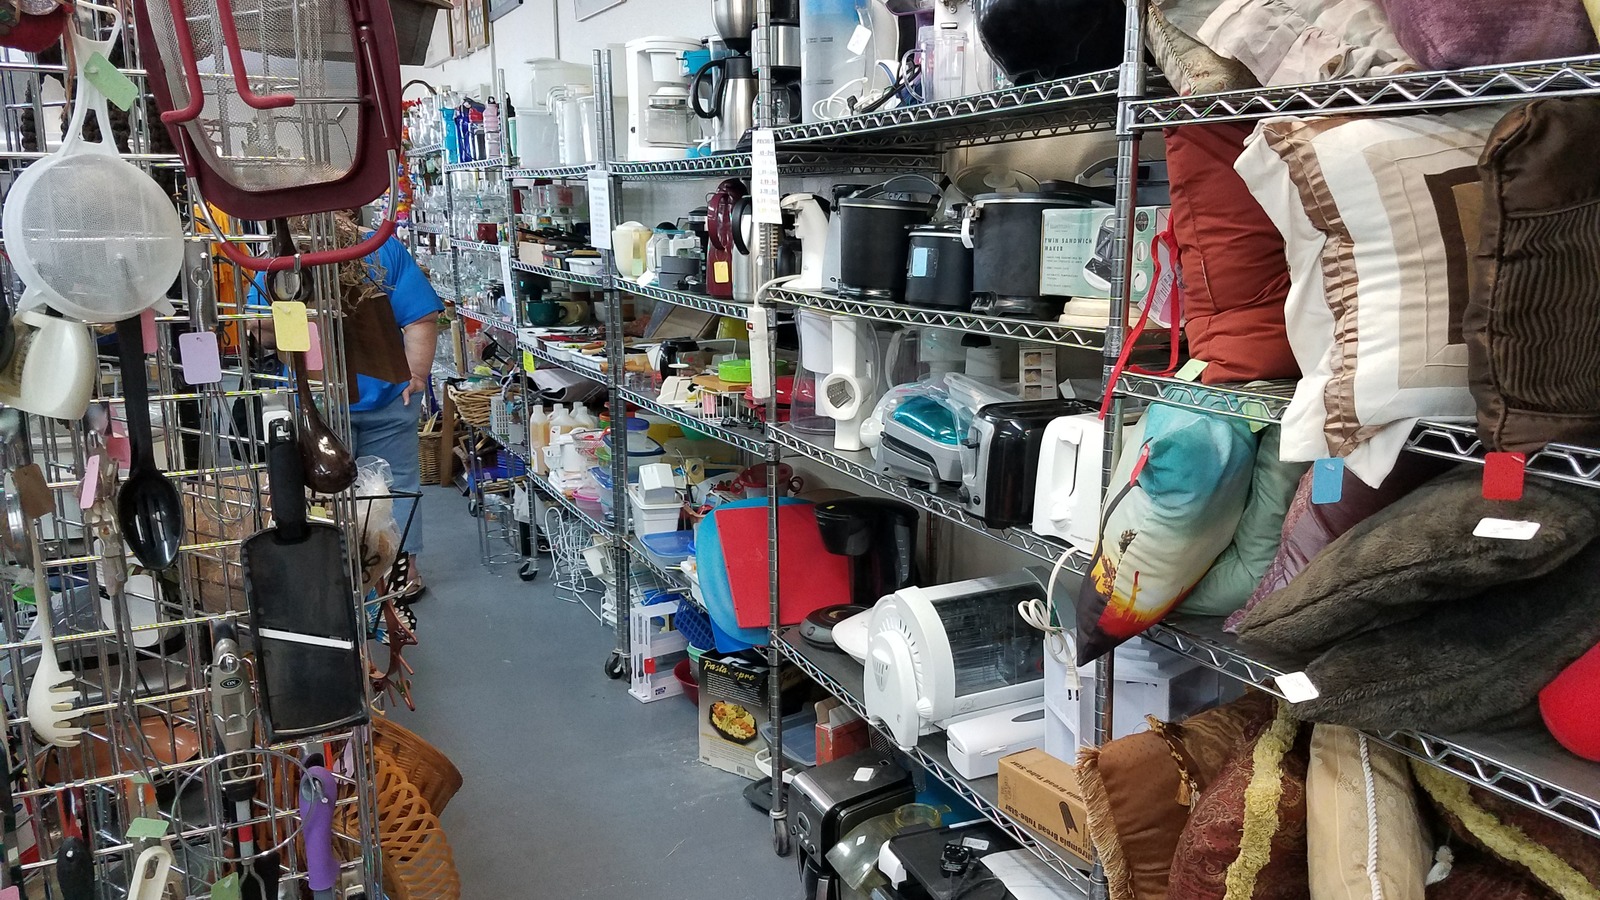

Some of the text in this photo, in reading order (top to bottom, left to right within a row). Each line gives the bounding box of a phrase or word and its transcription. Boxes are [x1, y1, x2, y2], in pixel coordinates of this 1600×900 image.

[703, 660, 728, 674] Pasta
[1043, 779, 1066, 794] Bread
[1004, 804, 1037, 829] Tube-Star
[1037, 823, 1059, 841] Bread
